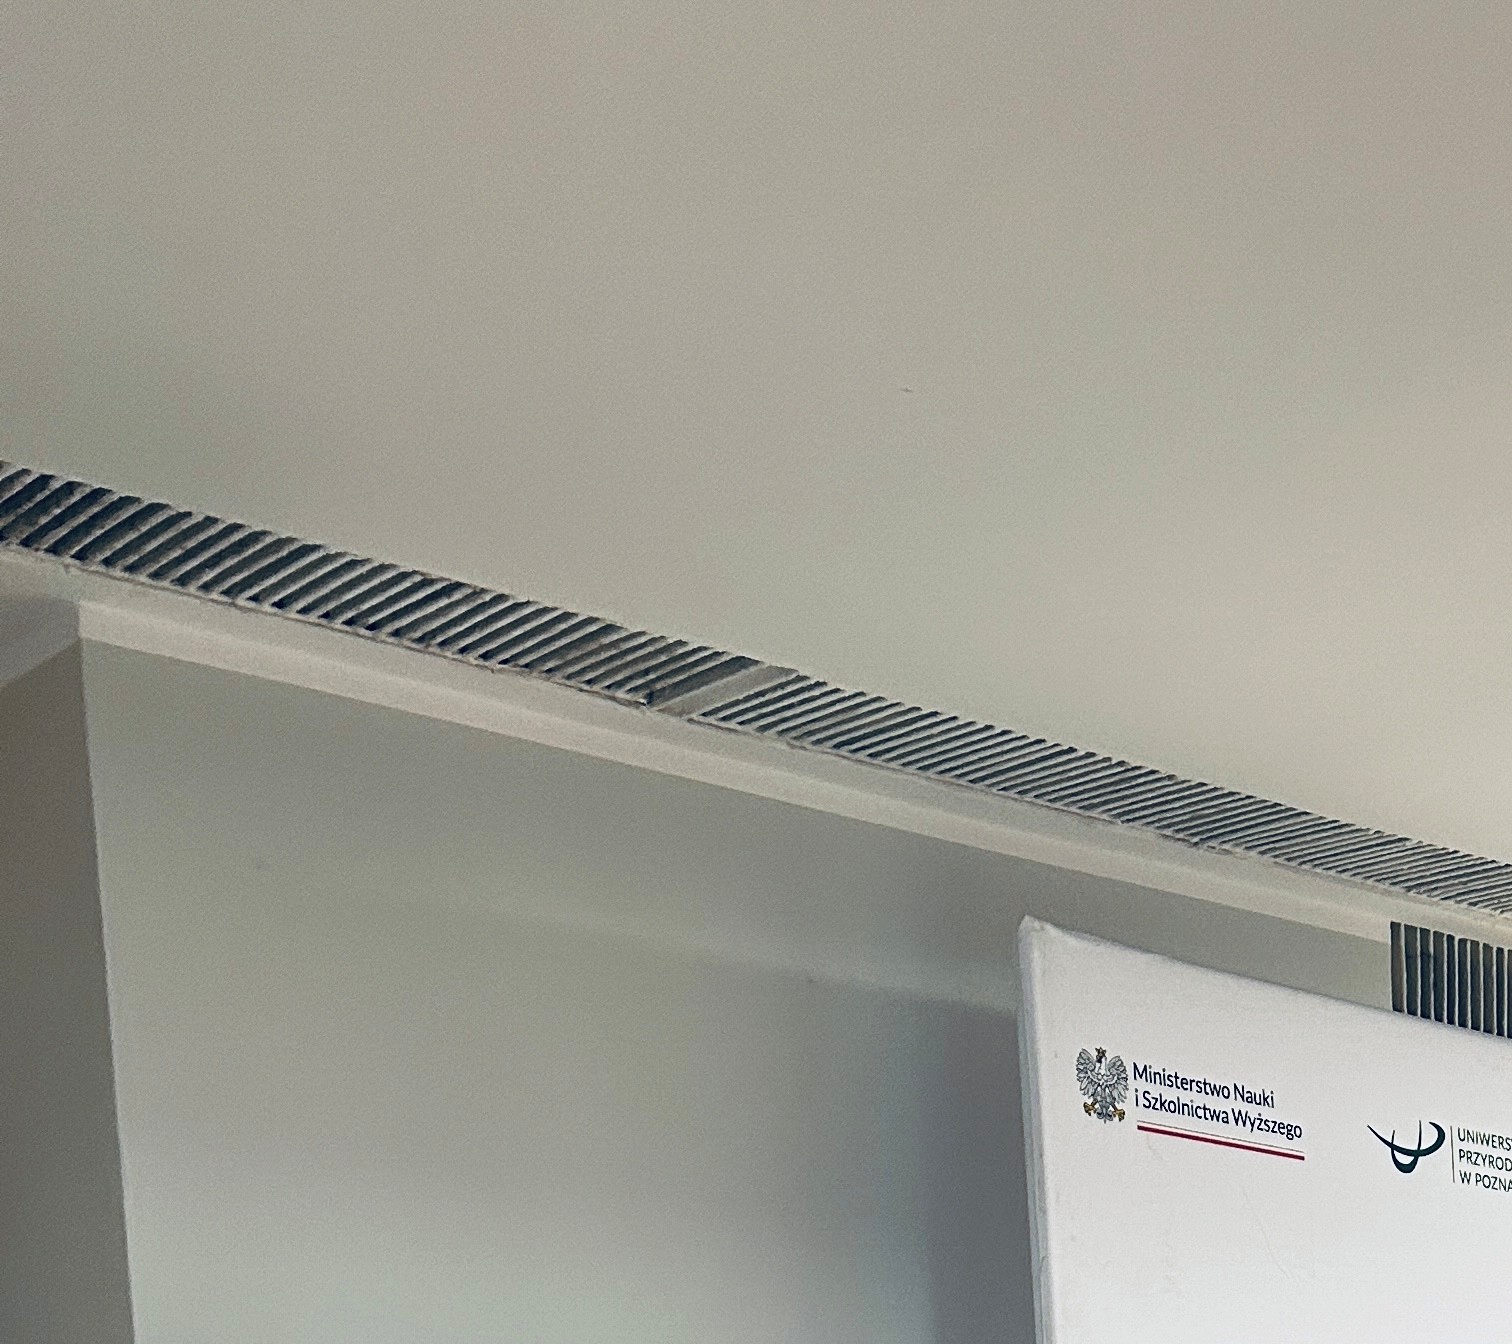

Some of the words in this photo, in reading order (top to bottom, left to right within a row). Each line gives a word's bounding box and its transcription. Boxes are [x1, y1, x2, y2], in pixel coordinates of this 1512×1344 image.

[1132, 1062, 1231, 1101] Ministerstwo
[1233, 1081, 1275, 1109] Nauki
[1134, 1089, 1140, 1108] i
[1142, 1089, 1230, 1125] Szkolnictwa
[1231, 1107, 1303, 1141] Wyższego
[1459, 1169, 1473, 1186] W
